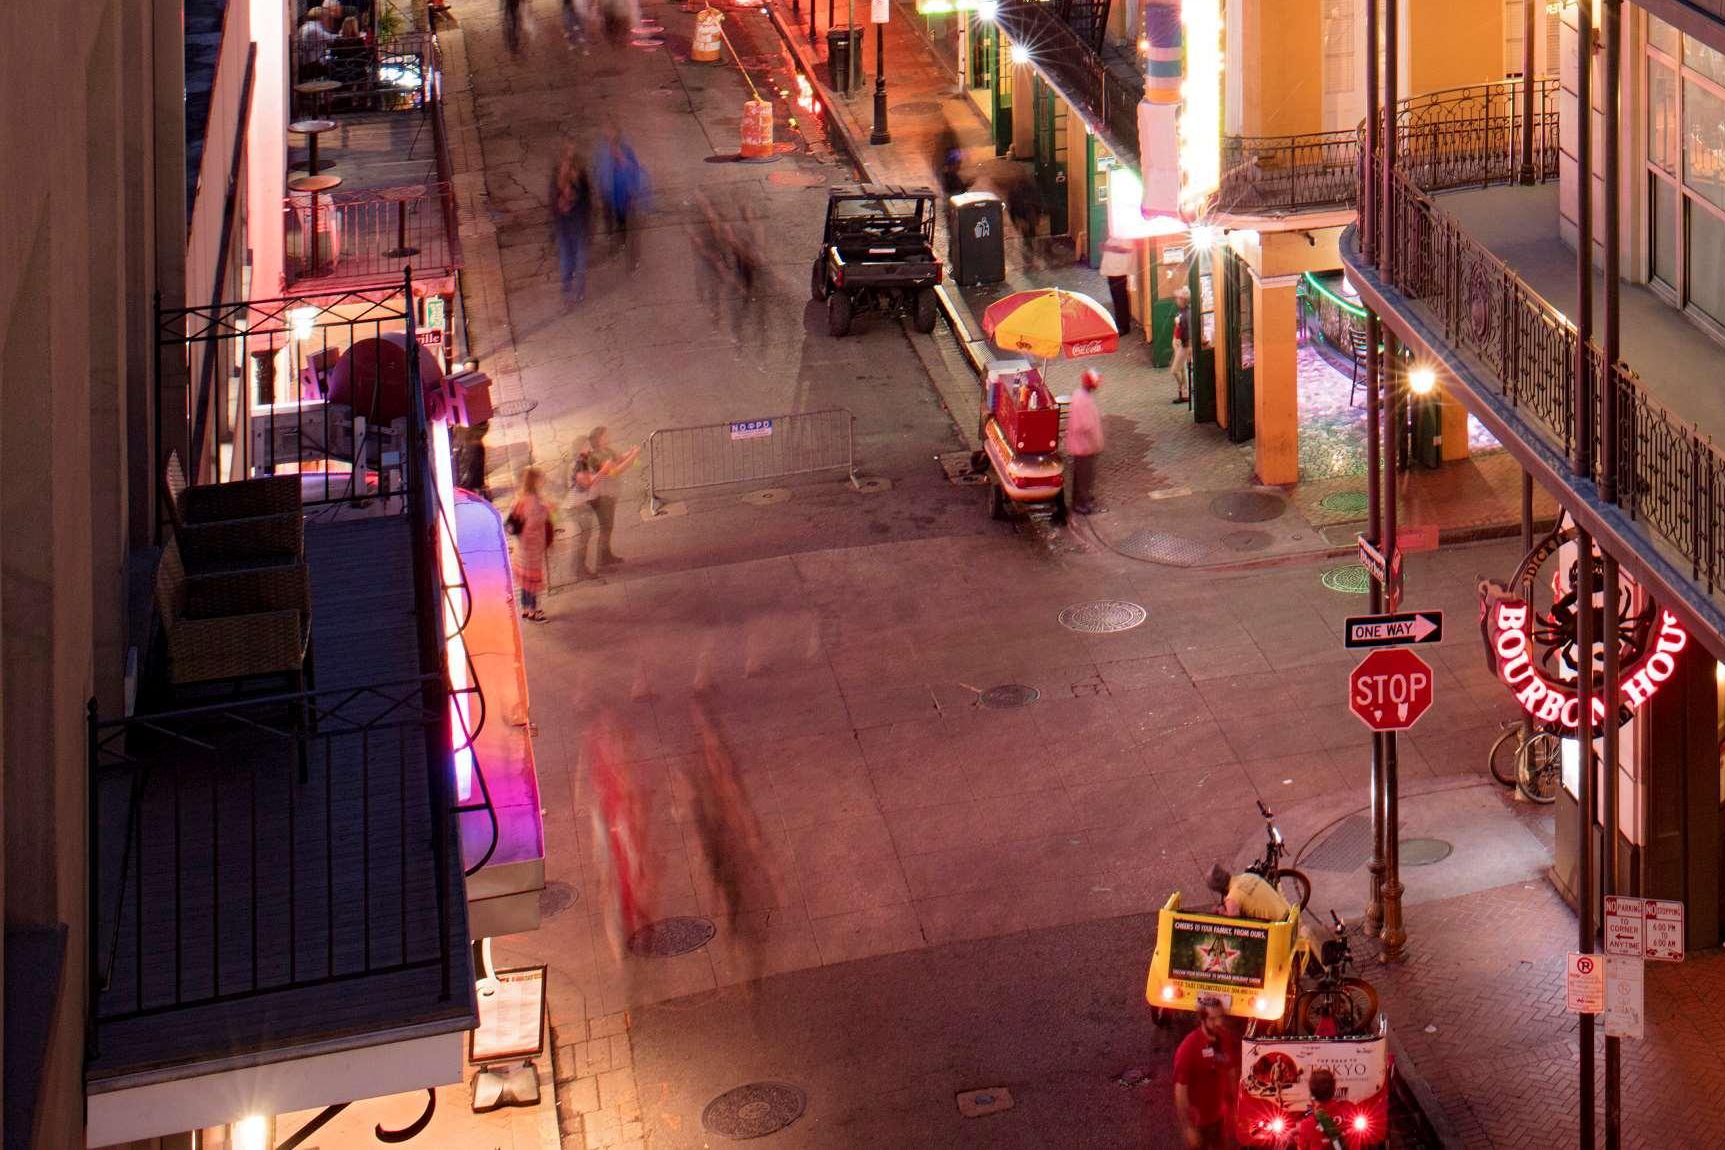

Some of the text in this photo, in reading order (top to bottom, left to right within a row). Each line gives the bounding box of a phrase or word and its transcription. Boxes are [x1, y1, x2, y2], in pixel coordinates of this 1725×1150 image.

[1355, 622, 1413, 639] ONE WAY
[1620, 609, 1687, 708] HOU
[1356, 672, 1427, 706] STOP
[1606, 900, 1641, 913] NO PARKING
[1646, 903, 1657, 915] NO
[1233, 928, 1249, 937] FROM
[1610, 924, 1639, 934] CORNER
[1609, 940, 1640, 950] ANYTIME
